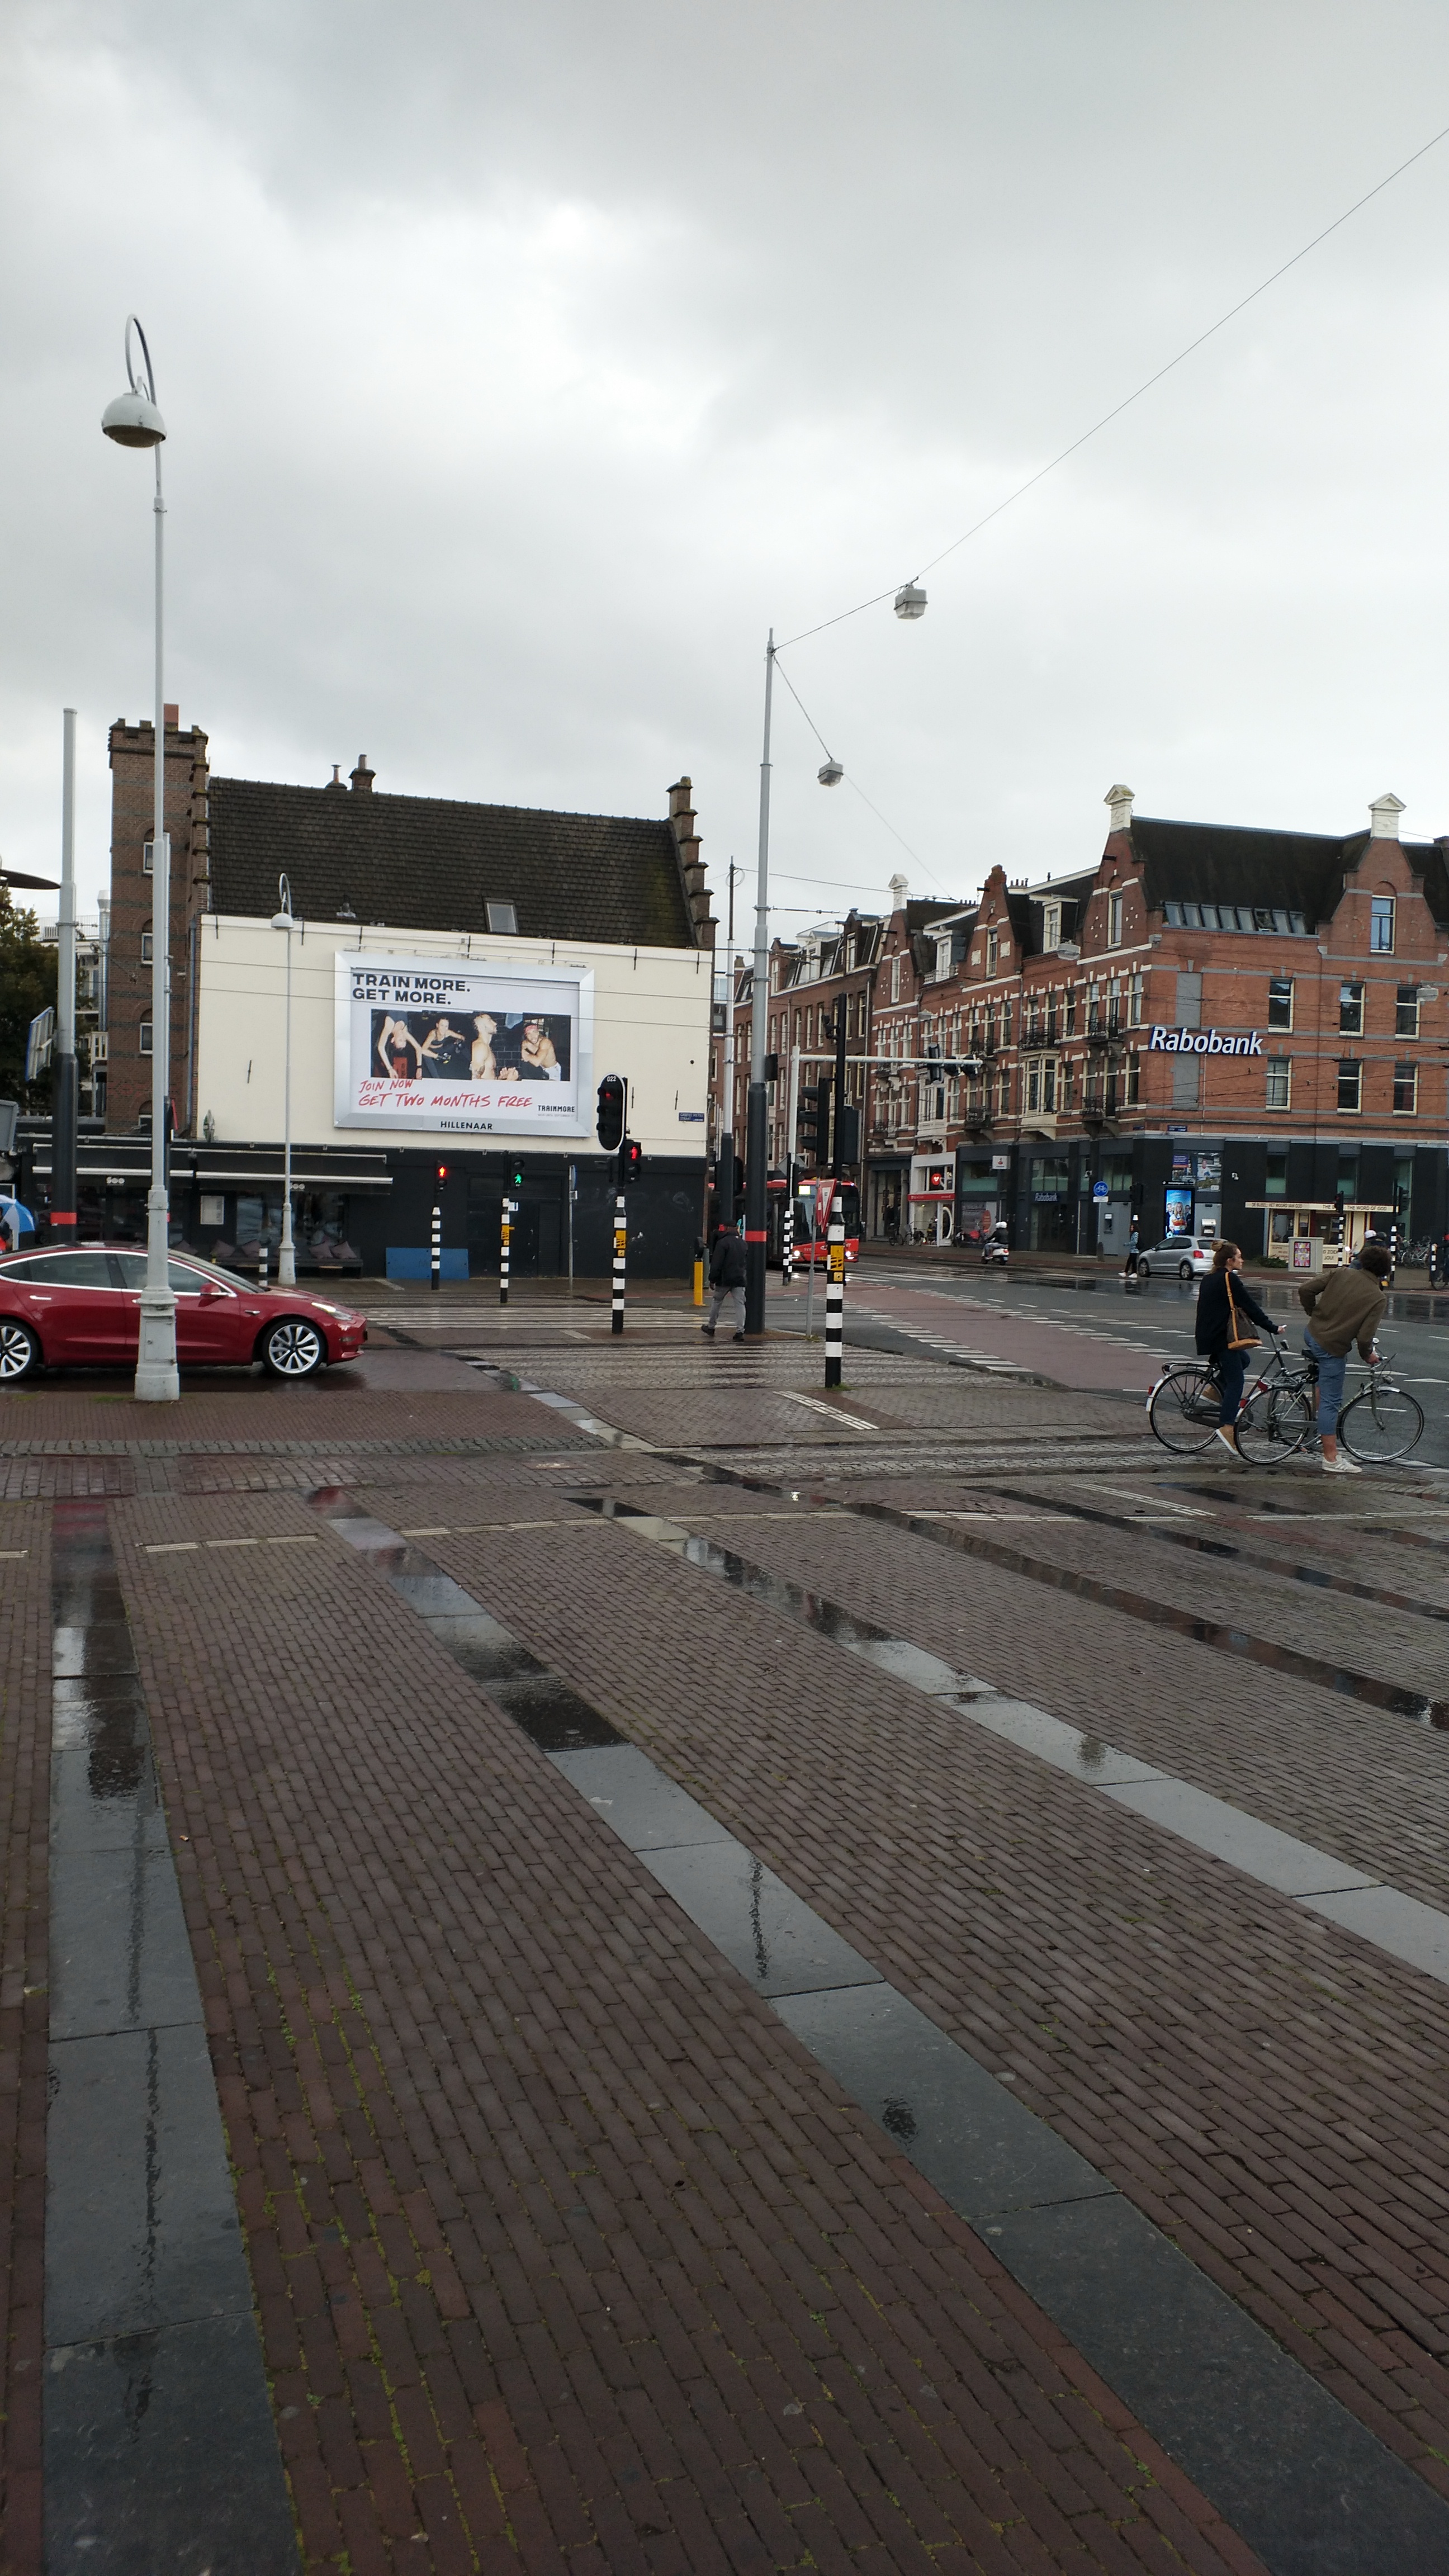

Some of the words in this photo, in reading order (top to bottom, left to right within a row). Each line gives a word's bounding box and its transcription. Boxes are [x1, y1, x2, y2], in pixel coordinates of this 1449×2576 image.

[353, 974, 410, 988] TRAIN
[415, 978, 470, 992] MORE.
[353, 987, 390, 1001] GET
[395, 990, 451, 1005] MORE.
[1149, 1026, 1263, 1055] Rabobank
[358, 1080, 385, 1093] JOIN
[389, 1079, 414, 1090] NOW
[358, 1093, 392, 1107] GET
[395, 1093, 424, 1107] TWO
[430, 1092, 491, 1107] MONTHS
[498, 1096, 533, 1107] FREE
[441, 1121, 493, 1130] HILLENAAR
[1035, 1192, 1058, 1201] Rabobank
